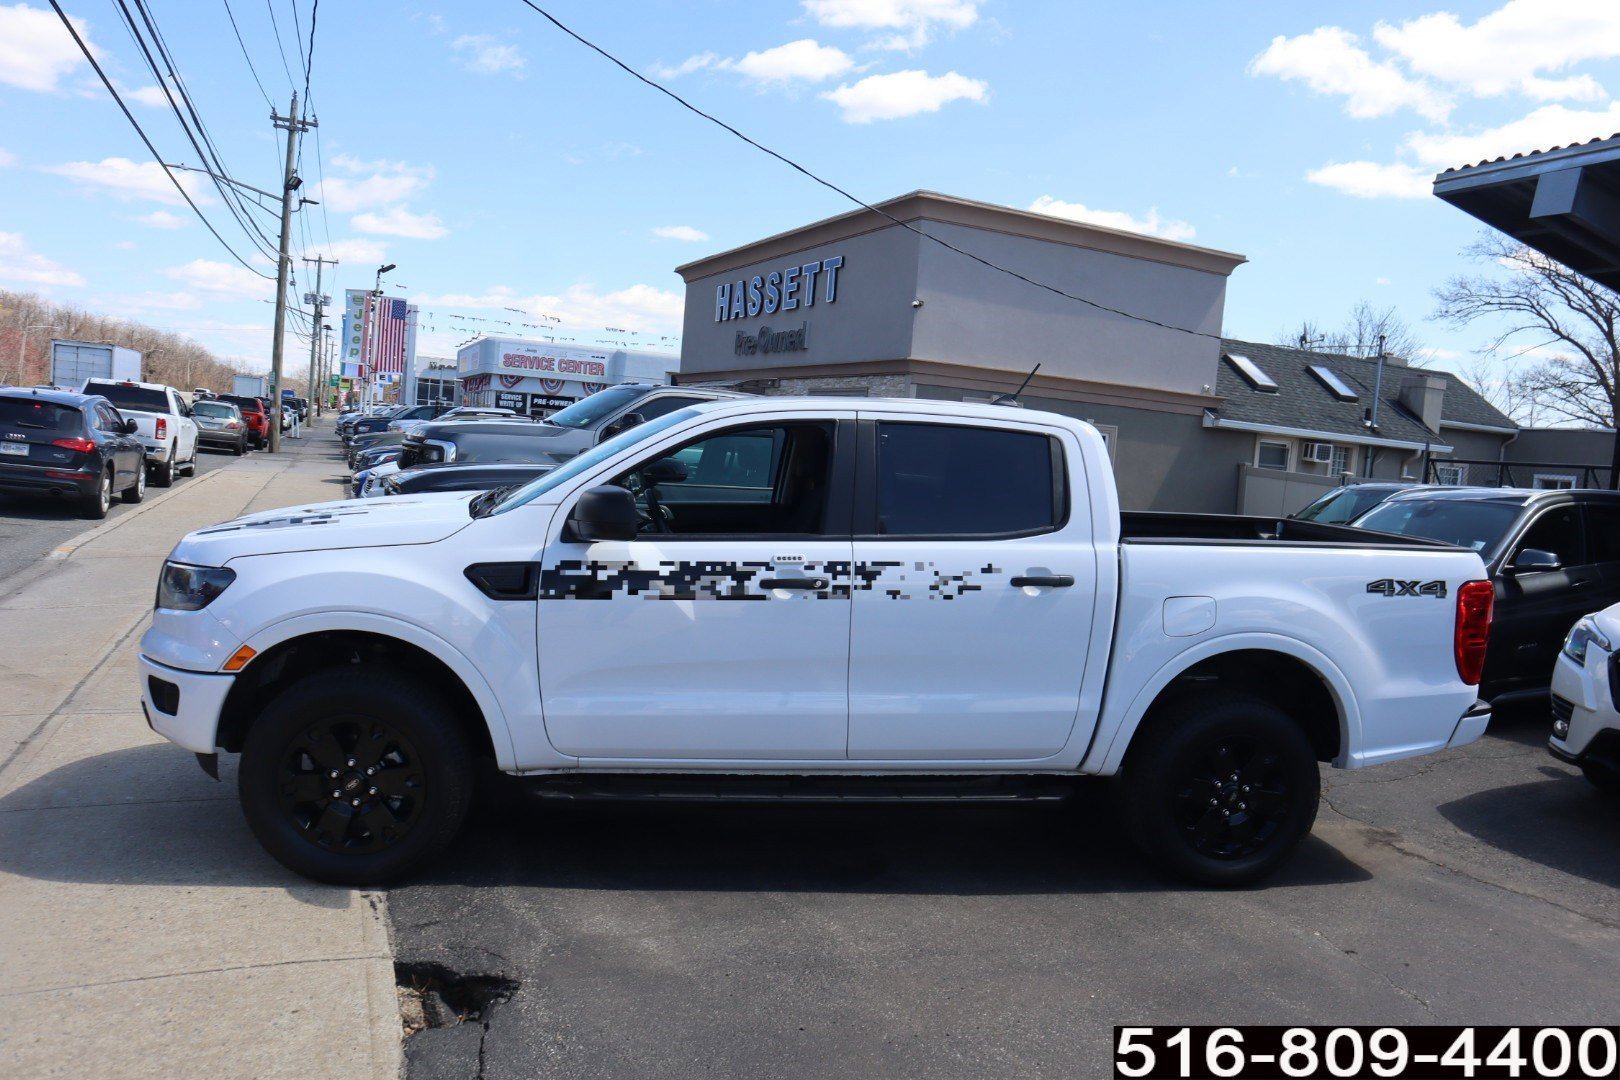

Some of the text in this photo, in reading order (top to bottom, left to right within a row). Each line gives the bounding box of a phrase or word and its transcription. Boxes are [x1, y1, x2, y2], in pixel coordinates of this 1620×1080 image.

[715, 256, 844, 321] HASSETT
[349, 308, 363, 358] Jeep
[503, 353, 605, 376] SERVICE CENTER
[533, 398, 573, 406] PRE-OWNED
